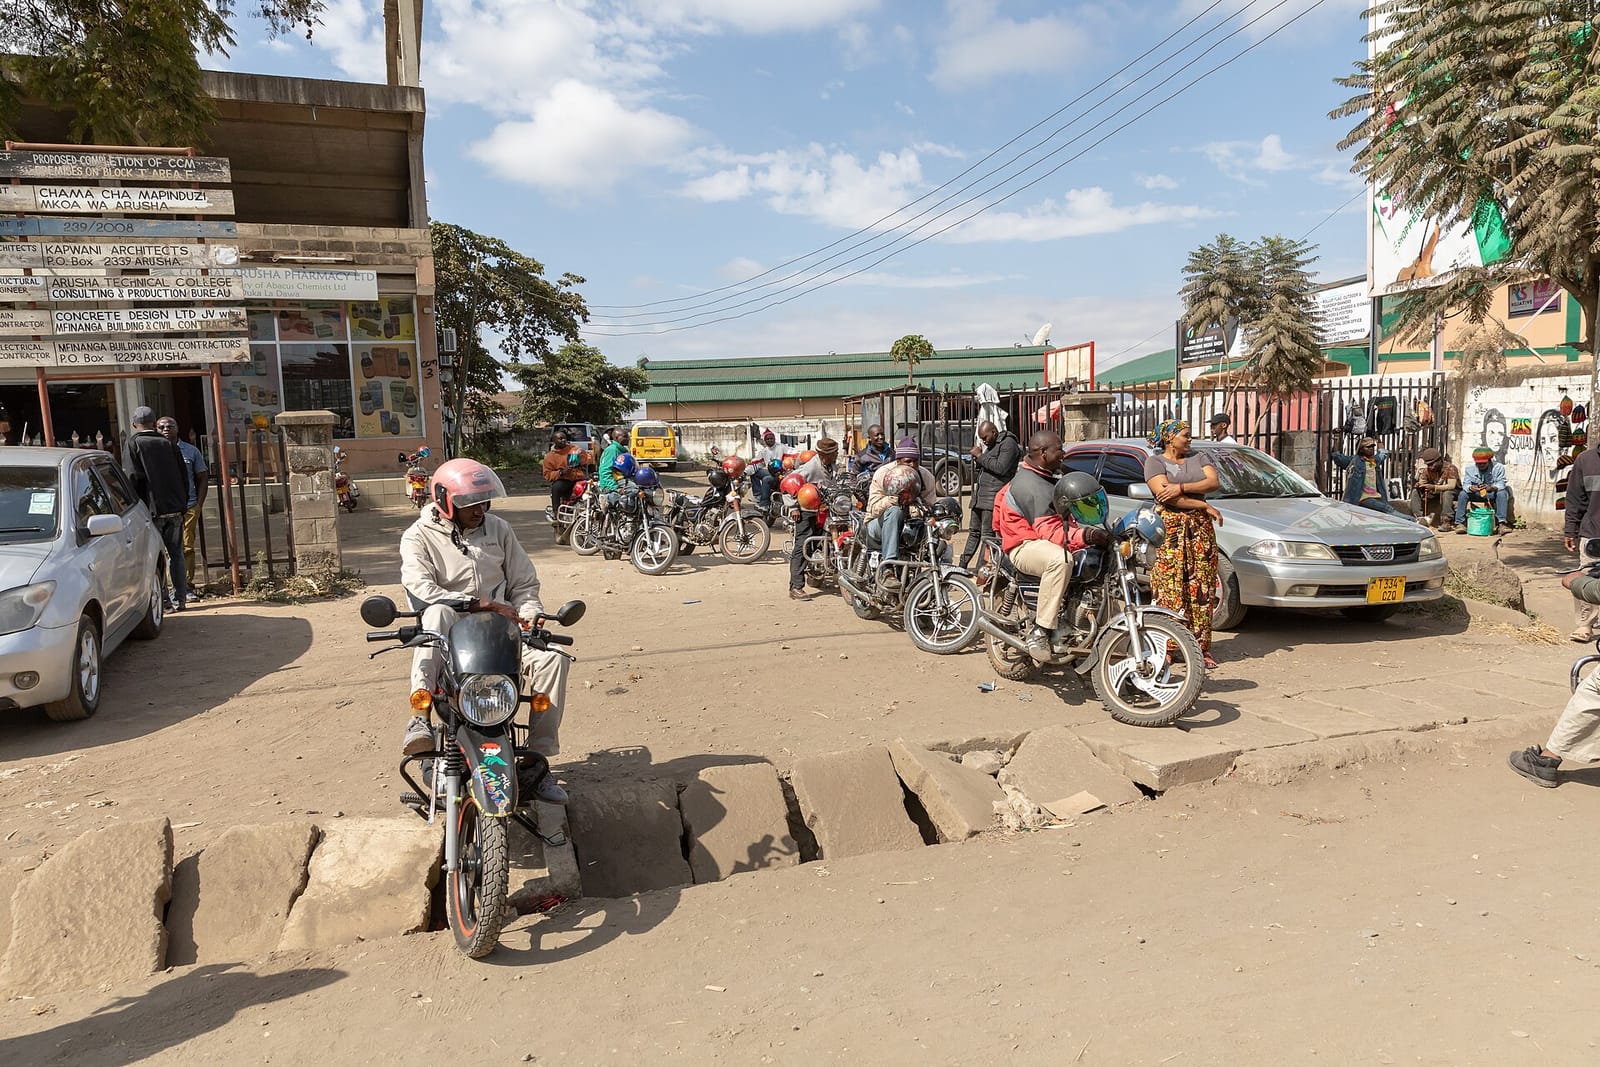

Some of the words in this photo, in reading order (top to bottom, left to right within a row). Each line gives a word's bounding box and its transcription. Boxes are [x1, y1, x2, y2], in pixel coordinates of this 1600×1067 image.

[33, 153, 77, 165] PROPOSED
[148, 158, 162, 167] OF
[168, 159, 195, 169] CCM
[85, 166, 99, 177] ON
[103, 167, 132, 177] BLOCK
[152, 169, 181, 179] AREA
[39, 188, 94, 199] CHAMA
[101, 189, 131, 199] CHA
[138, 191, 207, 201] MAPINDUZI
[40, 200, 81, 209] MKOA
[87, 201, 108, 210] WA
[115, 201, 168, 210] ARUSHA
[63, 221, 134, 233] 239/2008
[0, 244, 37, 252] CHITECTS
[45, 245, 102, 255] KAPWANI
[111, 246, 188, 255] ARCHITECTS
[47, 257, 68, 266] P.O.
[71, 257, 93, 266] Box
[104, 257, 131, 266] 2339
[285, 270, 352, 281] PHARMACY
[352, 271, 375, 282] LTD
[52, 278, 99, 288] ARUSHA
[104, 278, 169, 287] TECHNICAL
[176, 278, 232, 287] COLLEGE
[52, 289, 114, 299] CONSULTING
[118, 289, 124, 298] &
[128, 289, 187, 298] PRODUCTION
[191, 289, 231, 298] BUREAU
[56, 311, 121, 321] CONCRETE
[129, 310, 168, 320] DESIGN
[175, 310, 196, 319] LTD
[202, 310, 215, 319] JV
[56, 322, 102, 332] MFINANGA
[107, 321, 144, 332] BUILDING
[153, 320, 174, 330] CIVIL
[58, 342, 107, 352] MFINANGA
[178, 340, 240, 350] CONTRACTORS
[60, 354, 80, 363] P.O.
[84, 354, 104, 363] Box
[114, 353, 141, 362] 12293
[1509, 434, 1535, 453] SQUAD
